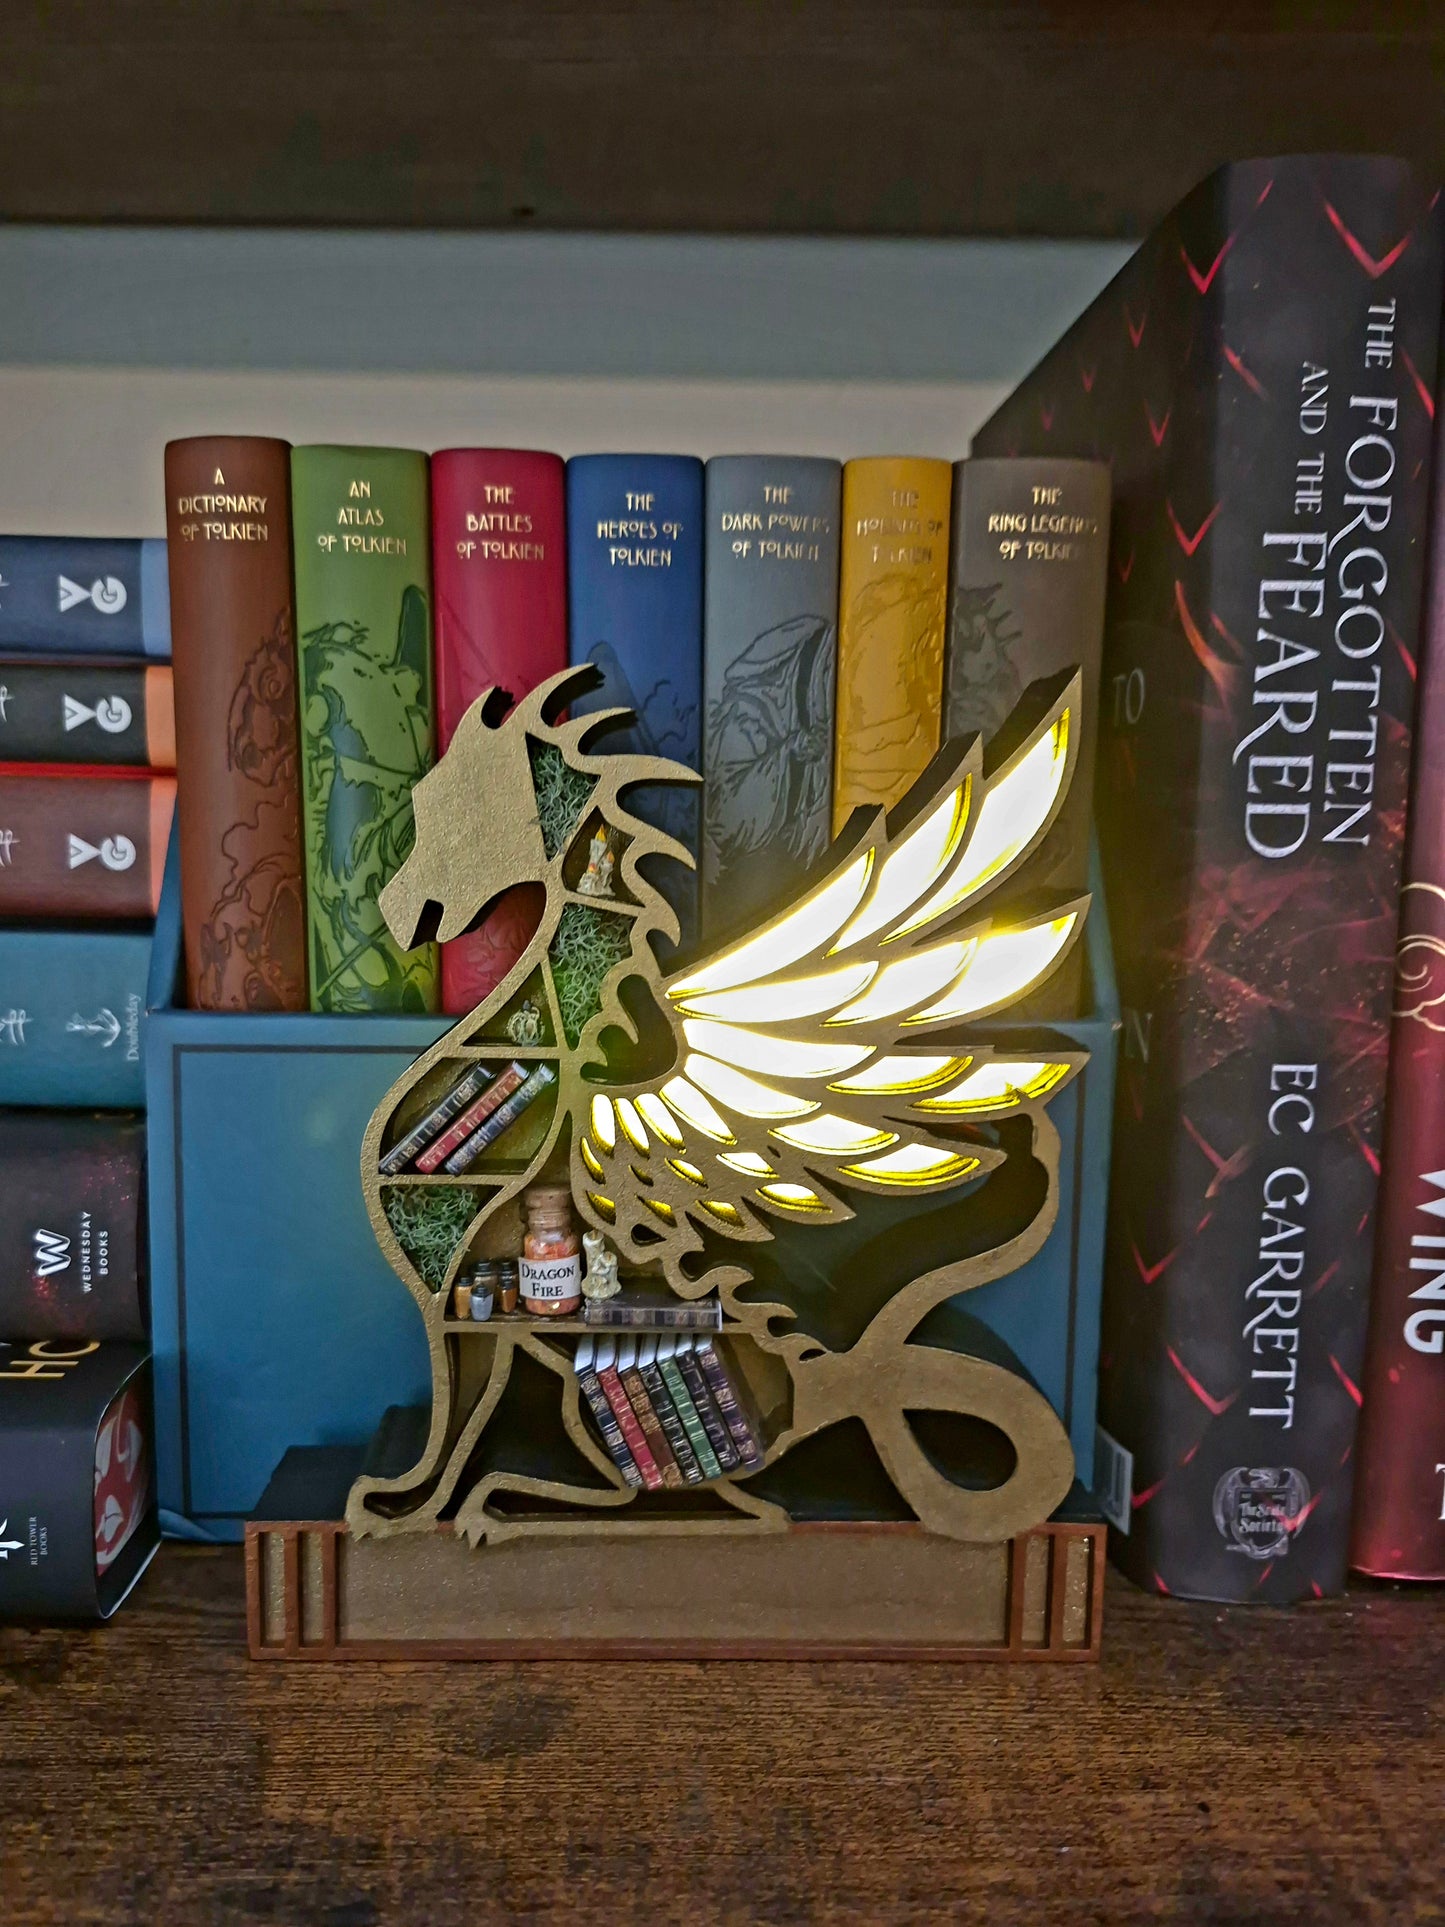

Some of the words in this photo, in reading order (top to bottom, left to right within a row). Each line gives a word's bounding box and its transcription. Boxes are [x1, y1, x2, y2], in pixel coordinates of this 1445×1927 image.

[1365, 298, 1397, 370] THE
[1301, 360, 1329, 434] AND
[214, 467, 226, 486] A
[1295, 452, 1325, 514] THE
[350, 480, 371, 499] AN
[484, 485, 514, 505] THE
[763, 485, 792, 505] THE
[1031, 485, 1063, 506] THE
[178, 494, 268, 515] DICTIONARY
[625, 492, 655, 512] THE
[337, 507, 385, 527] ATLAS
[466, 512, 534, 533] BATTLES
[721, 511, 763, 533] DARK
[987, 511, 1028, 534] RING
[1030, 512, 1097, 537] LEGEN
[181, 523, 200, 542] OF
[203, 522, 269, 542] TOLKIEN
[596, 519, 658, 540] HEROES
[662, 520, 684, 541] OF
[317, 534, 338, 553] OF
[342, 534, 408, 557] TOLKIEN
[456, 540, 477, 561] OF
[481, 541, 545, 562] TOLKIEN
[731, 539, 752, 560] OF
[999, 538, 1022, 561] OF
[1025, 539, 1080, 562] TOLKI
[608, 547, 673, 568] TOLKIEN
[1322, 395, 1398, 846] FORGOTTEN
[1232, 531, 1328, 859] FEARED
[1268, 1062, 1318, 1137] EC
[81, 1211, 92, 1295] WEDNESDAY
[99, 1230, 109, 1276] BOOKS
[521, 1263, 576, 1280] DRAGON
[531, 1283, 565, 1298] FIRE
[1242, 1166, 1311, 1430] GARRETT
